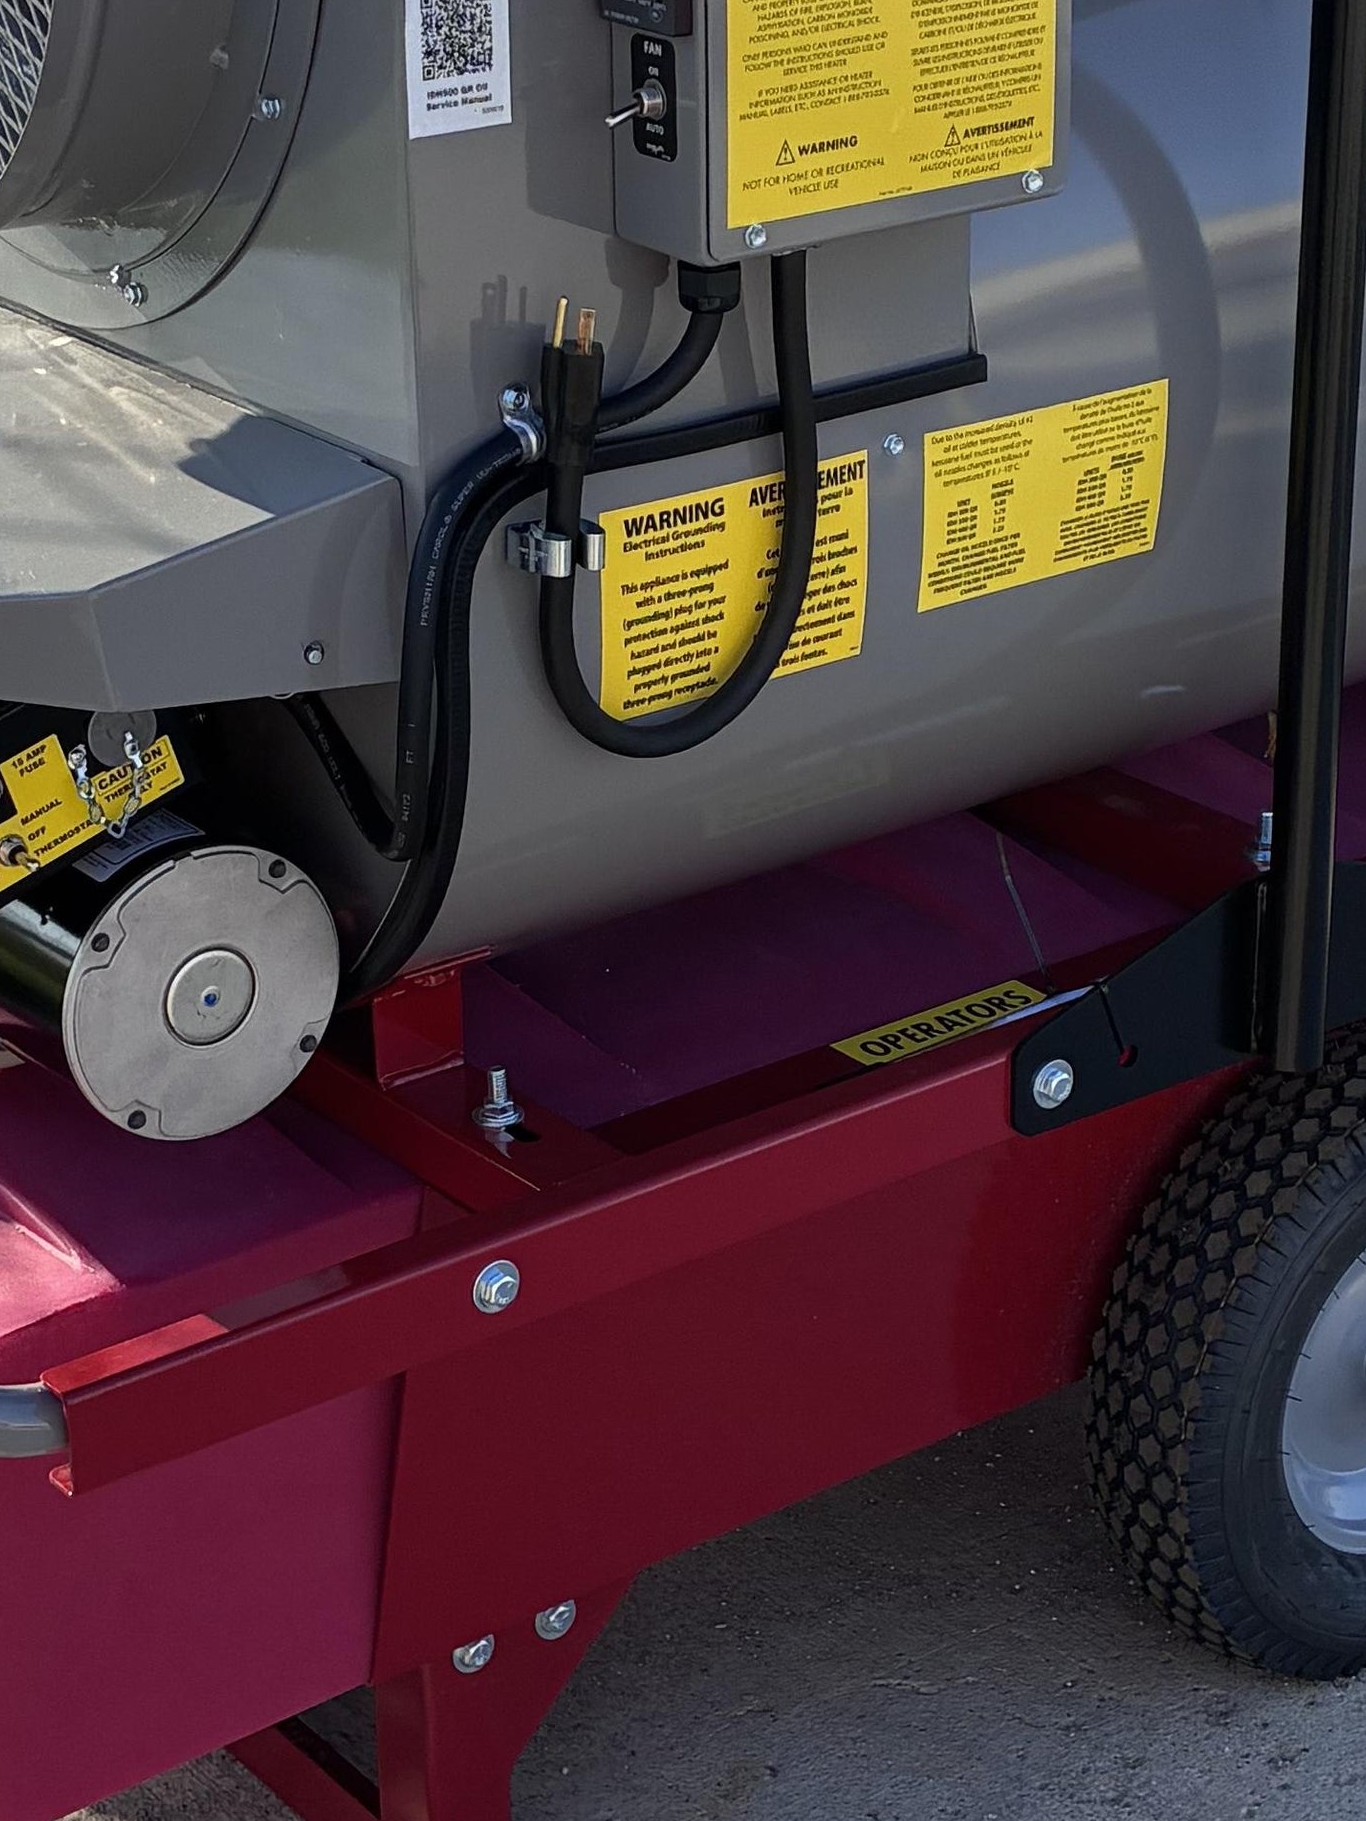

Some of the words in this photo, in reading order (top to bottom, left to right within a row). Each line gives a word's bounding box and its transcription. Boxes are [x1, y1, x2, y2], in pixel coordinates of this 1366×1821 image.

[643, 40, 662, 56] FAN
[426, 100, 459, 111] Service
[461, 92, 492, 105] Manual
[645, 122, 664, 135] AUTO
[963, 116, 1034, 138] AVERTISSEMENT
[798, 135, 857, 156] WARNING
[748, 459, 865, 507] AVEREMENT
[623, 495, 725, 539] WARNING
[622, 531, 670, 553] Electrical
[671, 518, 725, 543] Grounding
[644, 537, 705, 561] Instructions
[620, 581, 638, 596] This
[639, 571, 680, 594] appliance
[681, 569, 688, 580] is
[689, 558, 728, 581] equipped
[635, 595, 655, 609] with
[663, 580, 714, 604] three-prong
[622, 607, 673, 631] (grounding)
[674, 602, 693, 618] plug
[694, 598, 706, 610] for
[707, 595, 726, 609] your
[623, 625, 668, 647] protection
[669, 617, 700, 635] against
[701, 611, 724, 625] shock
[630, 644, 660, 660] hazard
[661, 639, 676, 651] and
[678, 632, 705, 647] should
[707, 628, 717, 639] be
[626, 660, 661, 679] plugged
[663, 651, 694, 670] directly
[695, 646, 712, 659] into
[713, 646, 718, 654] a
[633, 674, 669, 693] properly
[670, 662, 710, 683] grounded
[11, 757, 24, 770] 15
[26, 745, 47, 762] AMP
[19, 758, 46, 778] FUSE
[98, 746, 163, 790] CAUTON
[21, 799, 63, 826] MANUAL
[27, 826, 47, 842] OFF
[33, 819, 93, 857] THERMOSTA
[859, 990, 1032, 1056] OPERATORS
